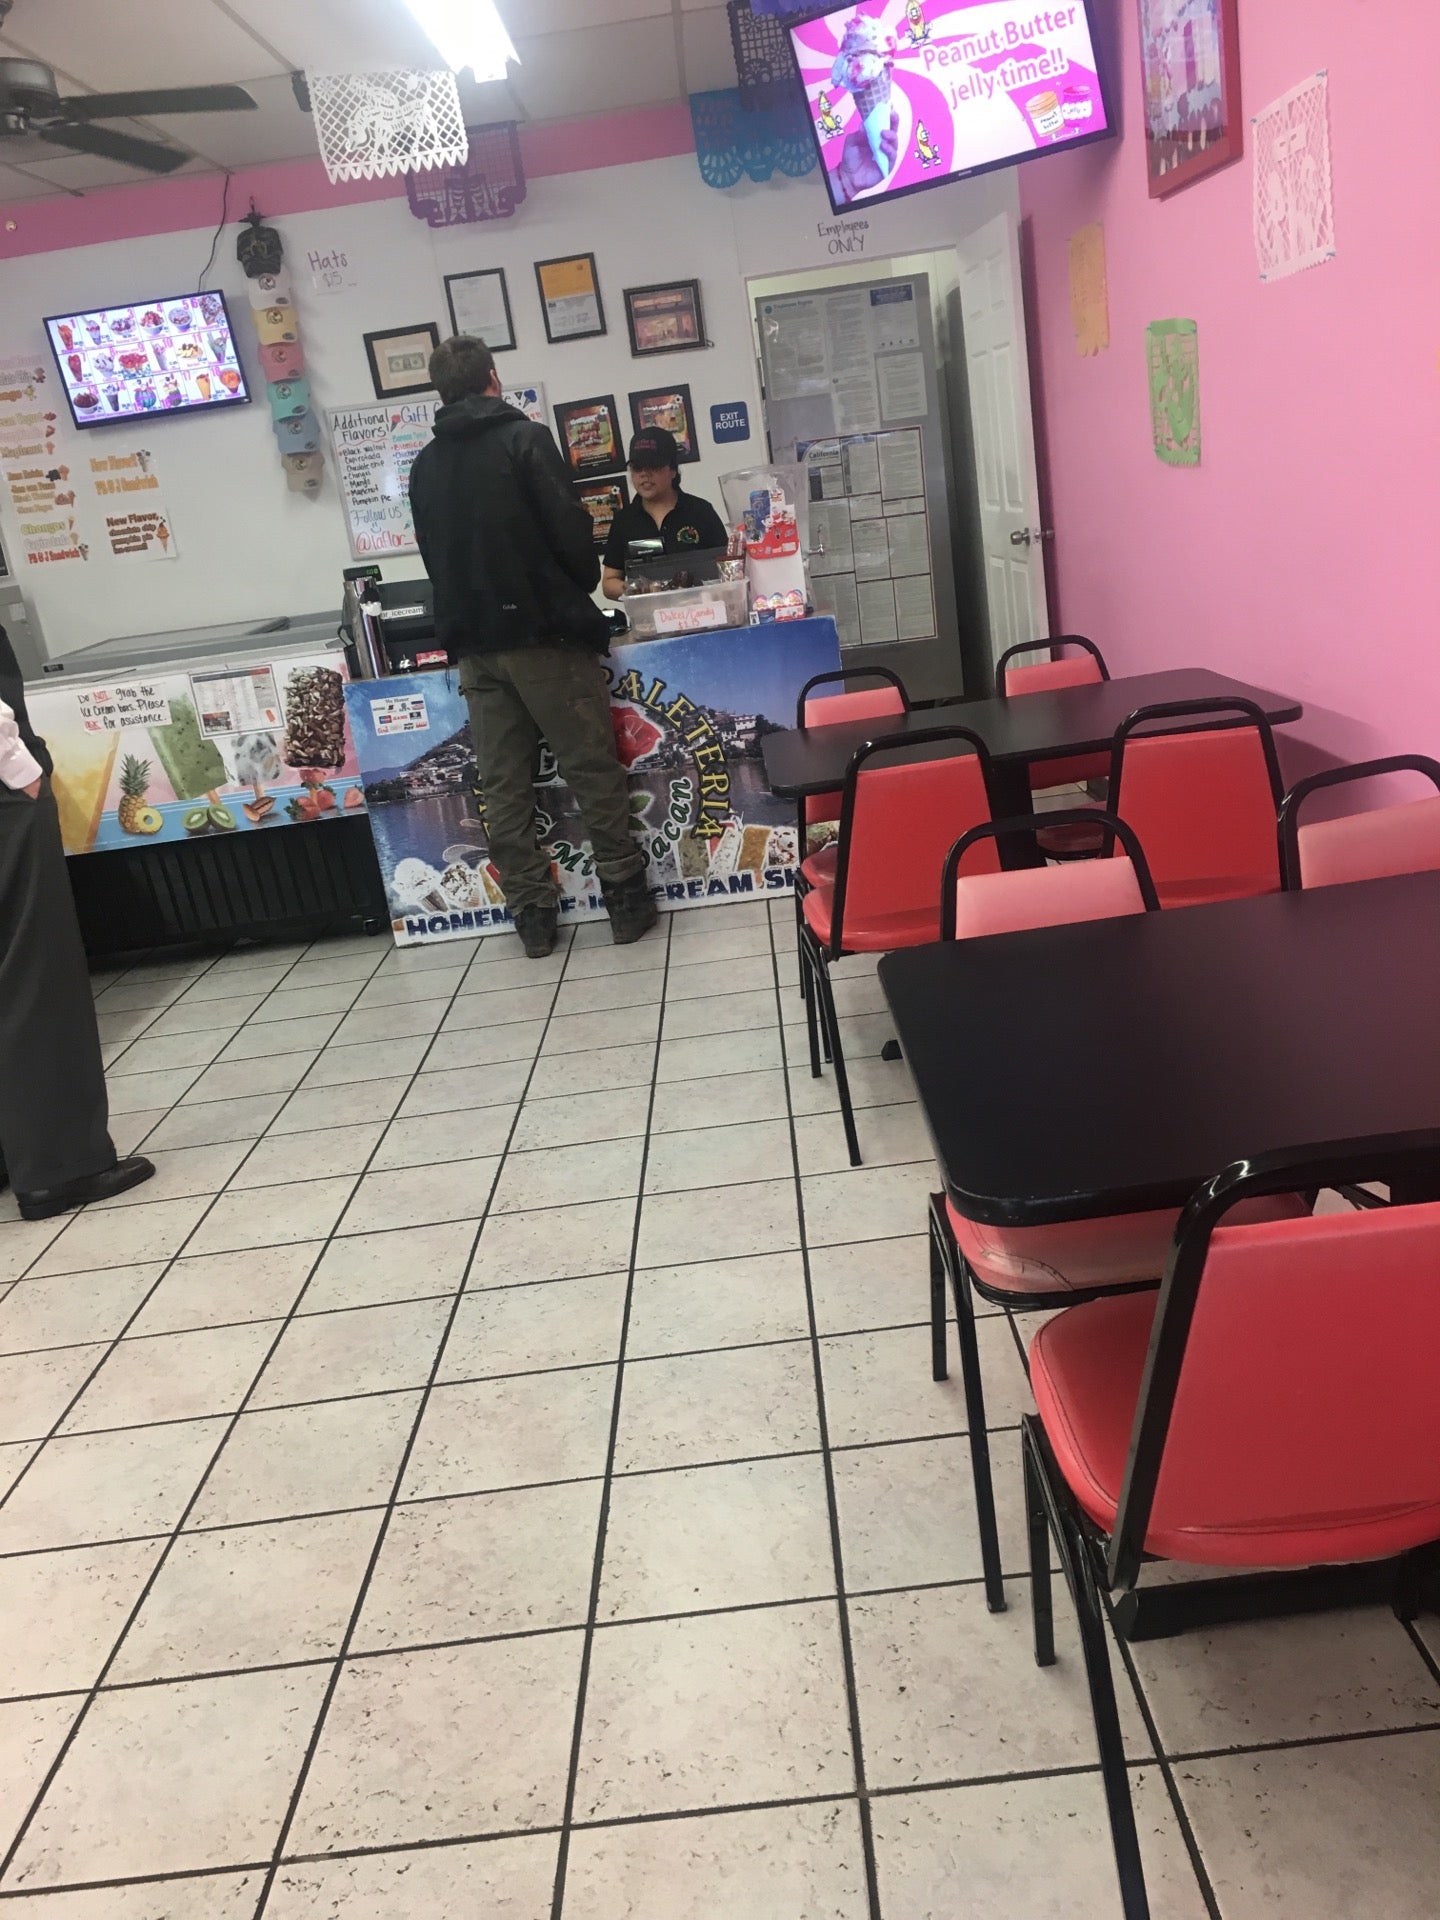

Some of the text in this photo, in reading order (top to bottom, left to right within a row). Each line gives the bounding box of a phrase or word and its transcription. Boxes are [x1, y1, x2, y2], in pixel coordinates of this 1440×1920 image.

[923, 7, 1075, 71] Peanut Butter
[950, 48, 1066, 110] jelly time!!
[817, 220, 869, 241] Employees
[828, 235, 864, 255] ONLY
[307, 250, 348, 271] Hats
[334, 408, 389, 431] Additional
[401, 405, 428, 424] Gift
[720, 411, 739, 421] EXIT
[715, 419, 746, 430] ROUTE
[809, 450, 839, 459] California
[106, 516, 127, 527] New
[351, 508, 386, 526] Follow
[115, 688, 137, 701] grab
[140, 686, 155, 697] the
[136, 699, 166, 711] Please
[103, 715, 116, 729] for
[551, 777, 691, 877] Miacan
